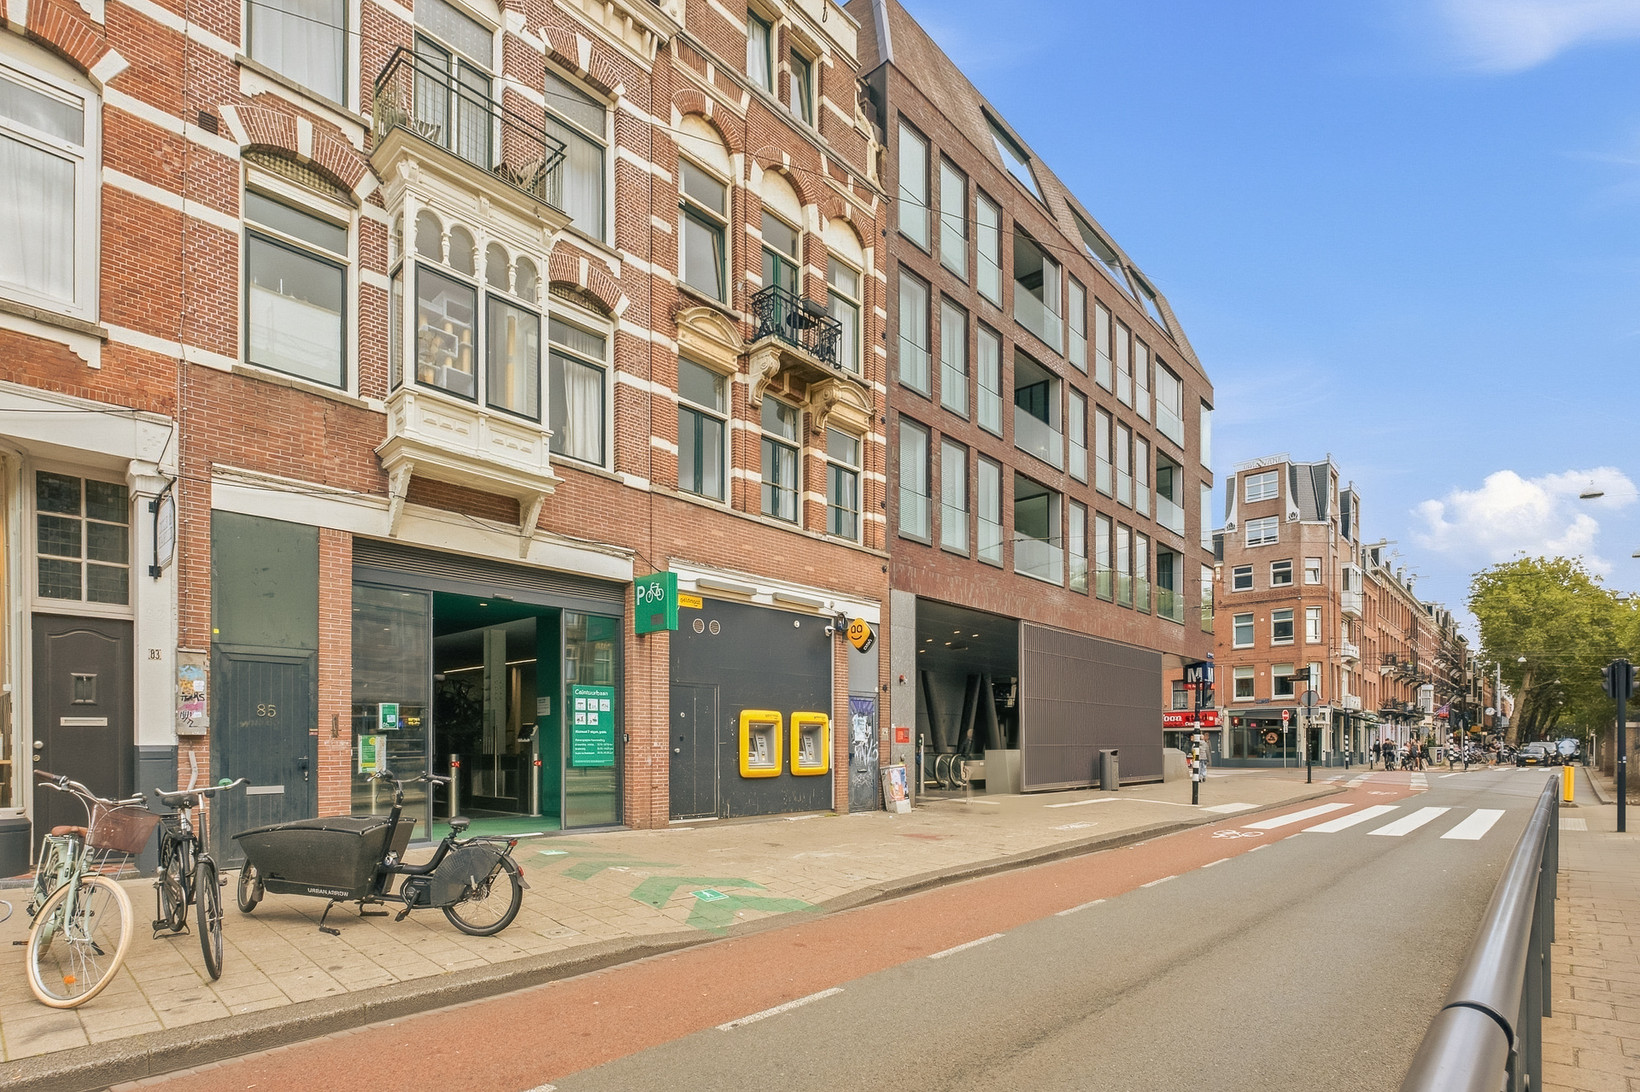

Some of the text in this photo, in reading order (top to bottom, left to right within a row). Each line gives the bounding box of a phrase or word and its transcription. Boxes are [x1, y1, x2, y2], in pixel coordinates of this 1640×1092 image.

[637, 585, 646, 606] P
[150, 649, 160, 660] 83
[1187, 666, 1203, 683] M
[256, 703, 277, 718] 85
